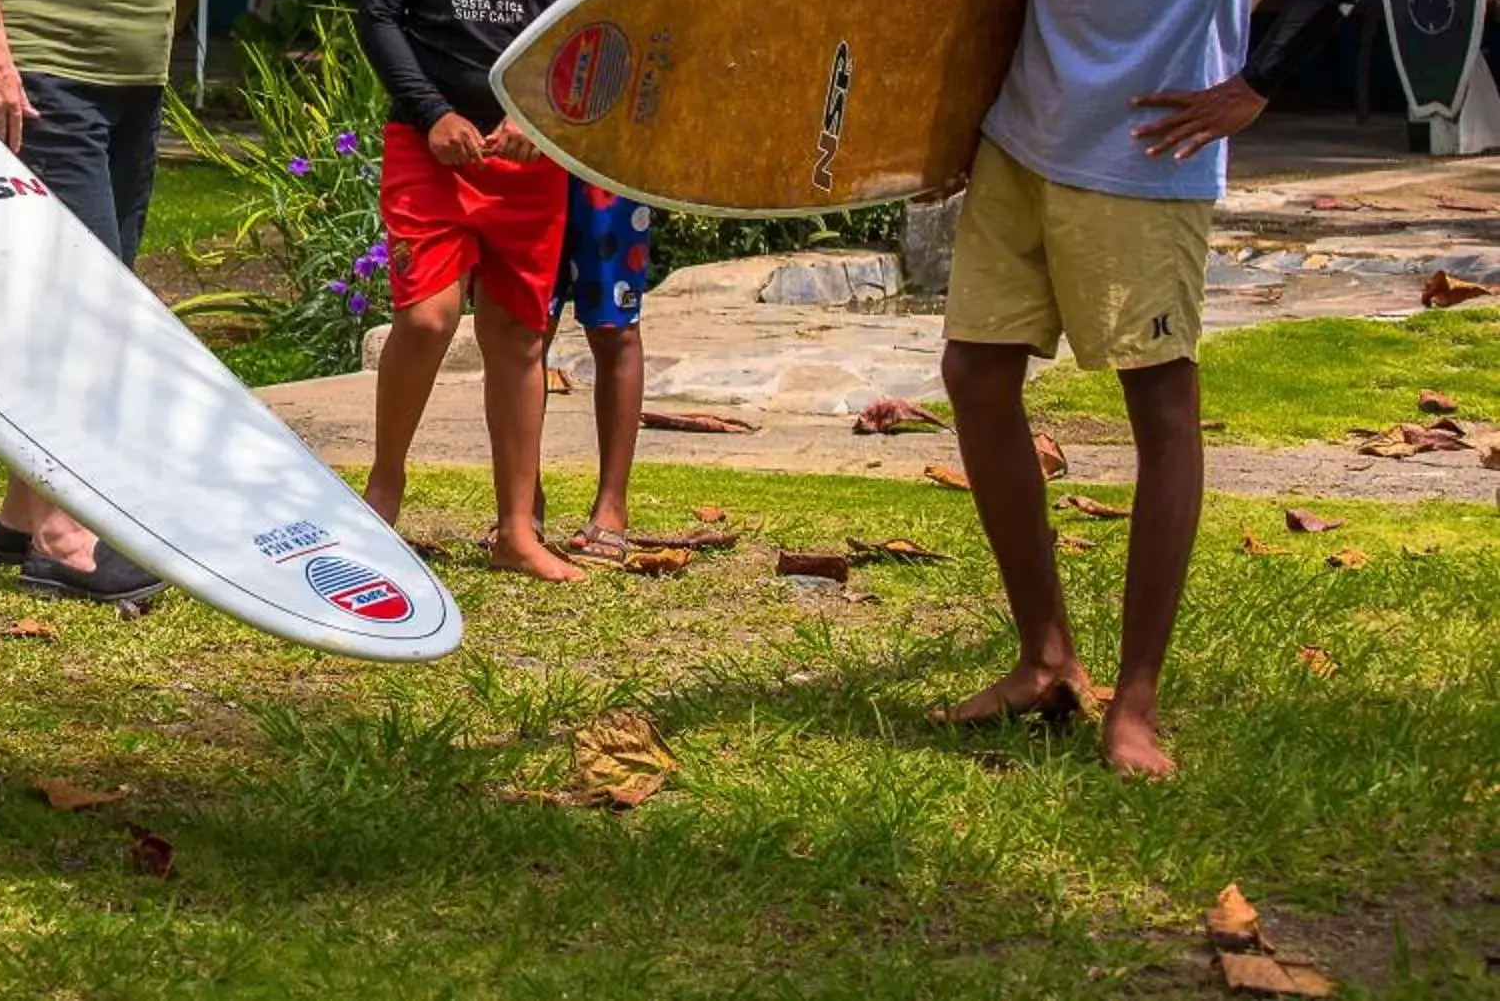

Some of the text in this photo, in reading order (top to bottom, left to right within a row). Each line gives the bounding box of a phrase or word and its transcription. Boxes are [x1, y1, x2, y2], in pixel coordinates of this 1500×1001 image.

[496, 0, 525, 13] RICA
[455, 8, 487, 22] SURF
[812, 40, 850, 192] NSP
